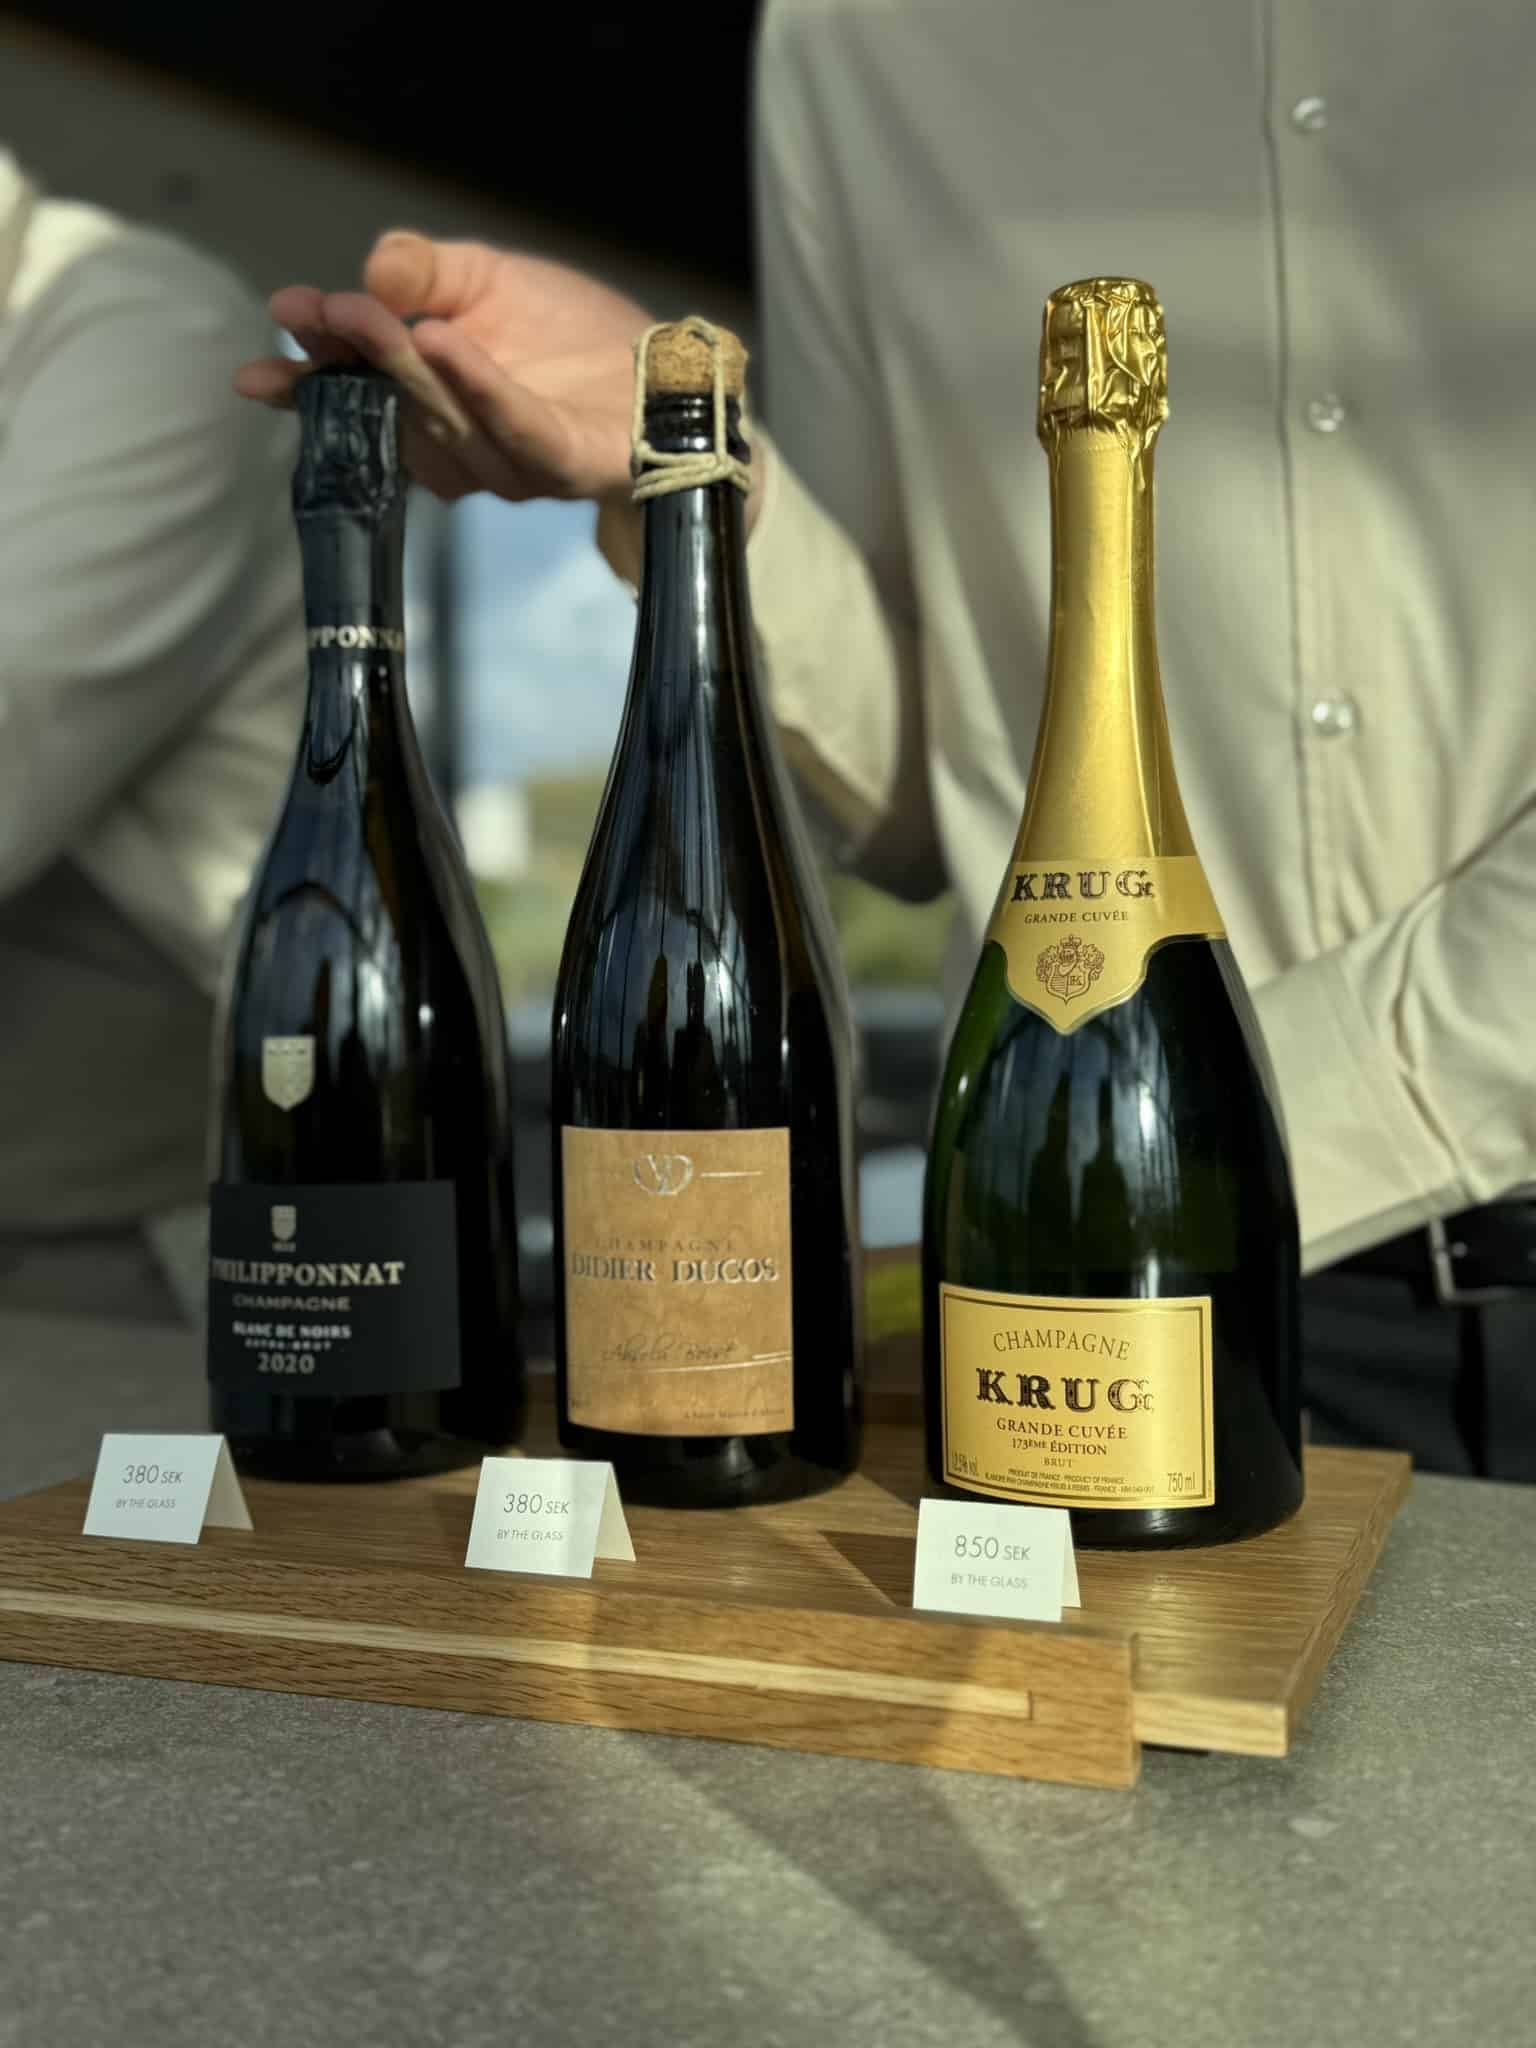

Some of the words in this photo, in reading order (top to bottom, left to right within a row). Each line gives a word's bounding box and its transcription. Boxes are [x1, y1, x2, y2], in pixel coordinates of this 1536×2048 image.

[1011, 870, 1154, 902] KRUG
[1025, 912, 1077, 925] GRANDE
[1082, 910, 1129, 922] CUVÉE
[595, 1237, 737, 1252] CHAMPAGNE
[572, 1254, 657, 1283] DIDIER
[232, 1293, 352, 1312] CHAMPAGNE
[276, 1324, 295, 1338] DE
[299, 1325, 352, 1340] NOIRS
[993, 1329, 1131, 1361] CHAMPAGNE
[257, 1354, 315, 1374] 2020
[976, 1368, 1155, 1413] KRUG
[996, 1417, 1064, 1437] GRANDE
[1068, 1423, 1129, 1440] CUVÉE
[1050, 1439, 1108, 1456] ÉDITION
[1044, 1458, 1074, 1468] BRUT
[122, 1464, 160, 1484] 380
[161, 1471, 184, 1485] SEK
[1168, 1473, 1184, 1493] 750
[1185, 1472, 1196, 1490] ml
[115, 1498, 127, 1509] BY
[128, 1498, 146, 1509] THE
[146, 1498, 176, 1510] GLASS
[503, 1493, 543, 1514] 380
[545, 1500, 569, 1515] SEK
[496, 1528, 510, 1540] BY
[511, 1529, 529, 1541] THE
[531, 1530, 564, 1542] GLASS
[954, 1534, 1000, 1560] 850
[1002, 1544, 1032, 1561] SEK
[951, 1573, 964, 1585] BY
[967, 1573, 986, 1588] THE
[989, 1576, 1028, 1591] GLASS
